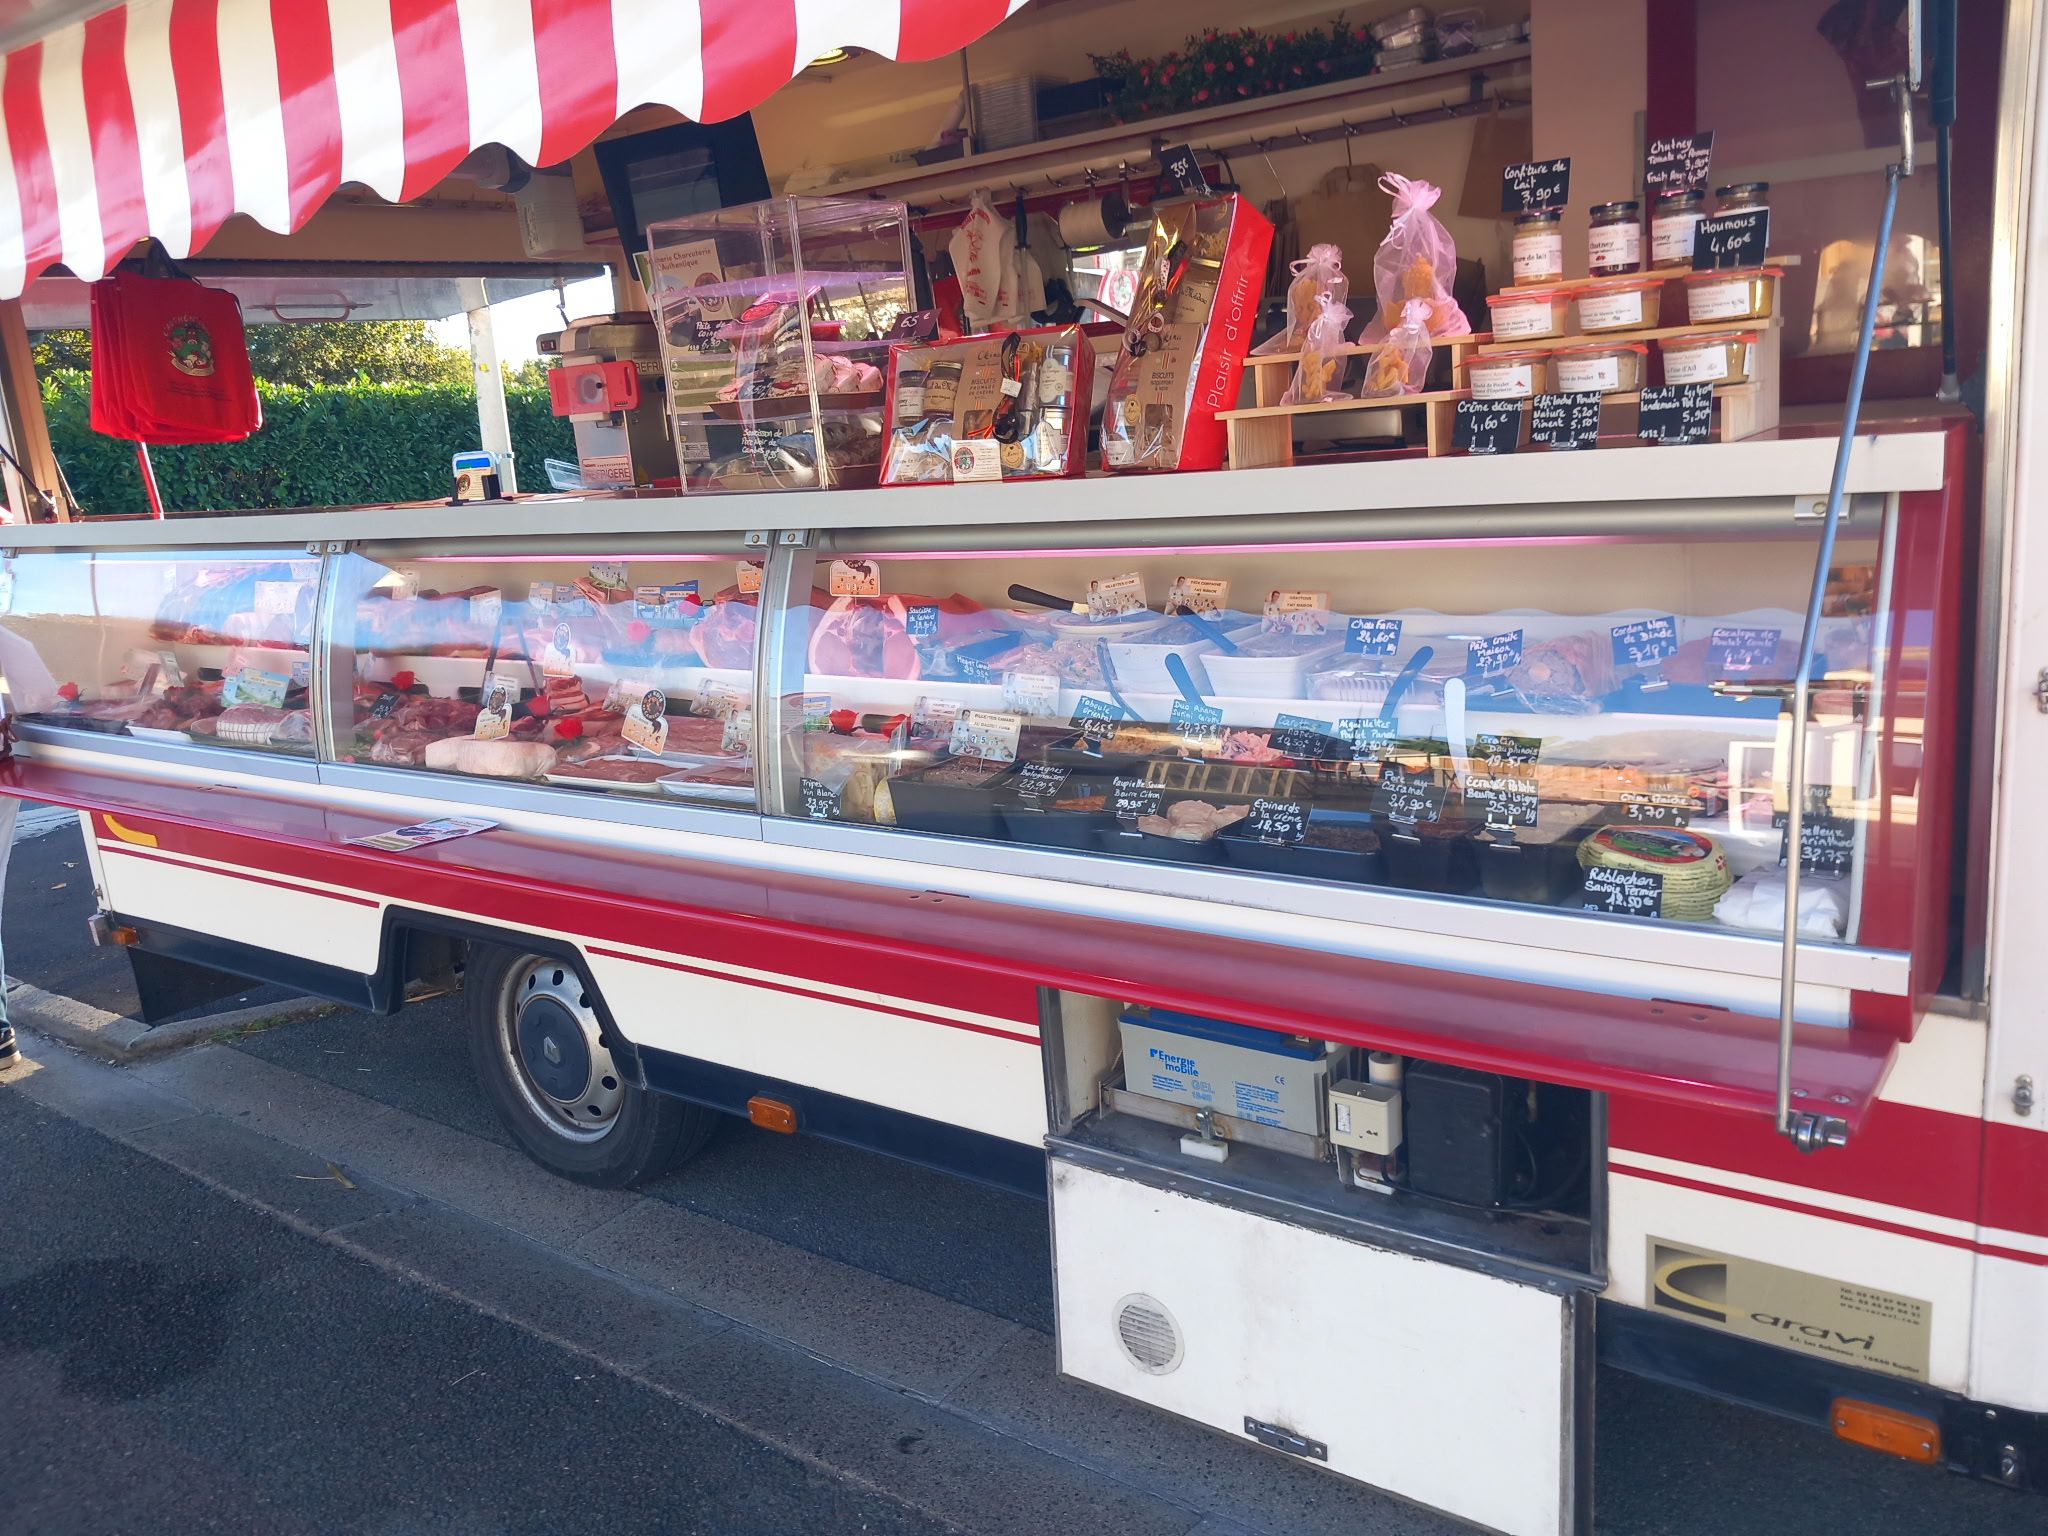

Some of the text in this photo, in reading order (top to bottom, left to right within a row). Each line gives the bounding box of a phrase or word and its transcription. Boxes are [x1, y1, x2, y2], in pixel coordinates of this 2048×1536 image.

[1651, 139, 1692, 154] Chutney
[1170, 157, 1189, 180] 35€
[1504, 159, 1566, 181] Confiture de
[1513, 175, 1537, 190] Lait
[1700, 215, 1756, 235] Houmous
[1710, 232, 1751, 254] 4,60€
[901, 315, 919, 328] 65
[1207, 274, 1249, 408] Plaisir d'offrir
[1151, 371, 1175, 380] BISCUITS
[1641, 387, 1658, 400] Fine
[1659, 386, 1675, 399] Ail
[1533, 408, 1566, 419] Nature
[1470, 413, 1508, 433] 4,60€
[1532, 418, 1564, 429] Piment
[1375, 619, 1399, 630] Farci
[1639, 627, 1675, 642] Dinde
[1081, 697, 1114, 715] Taboulé
[1174, 700, 1190, 711] Duo
[1479, 735, 1515, 746] Gratin
[1023, 762, 1064, 775] Lasagnes
[802, 779, 823, 790] Tripes
[1384, 770, 1428, 788] Porc au
[802, 788, 837, 798] Vin Blanc
[1381, 781, 1425, 797] Caramel
[1253, 798, 1301, 814] Epinards
[1628, 803, 1665, 822] 3,70
[1260, 810, 1270, 820] la
[1250, 818, 1291, 832] 18,50
[1589, 867, 1657, 888] Reblochon
[1584, 880, 1663, 897] Savoie Fermier
[1158, 1050, 1196, 1067] Energie
[1165, 1063, 1199, 1077] mobile
